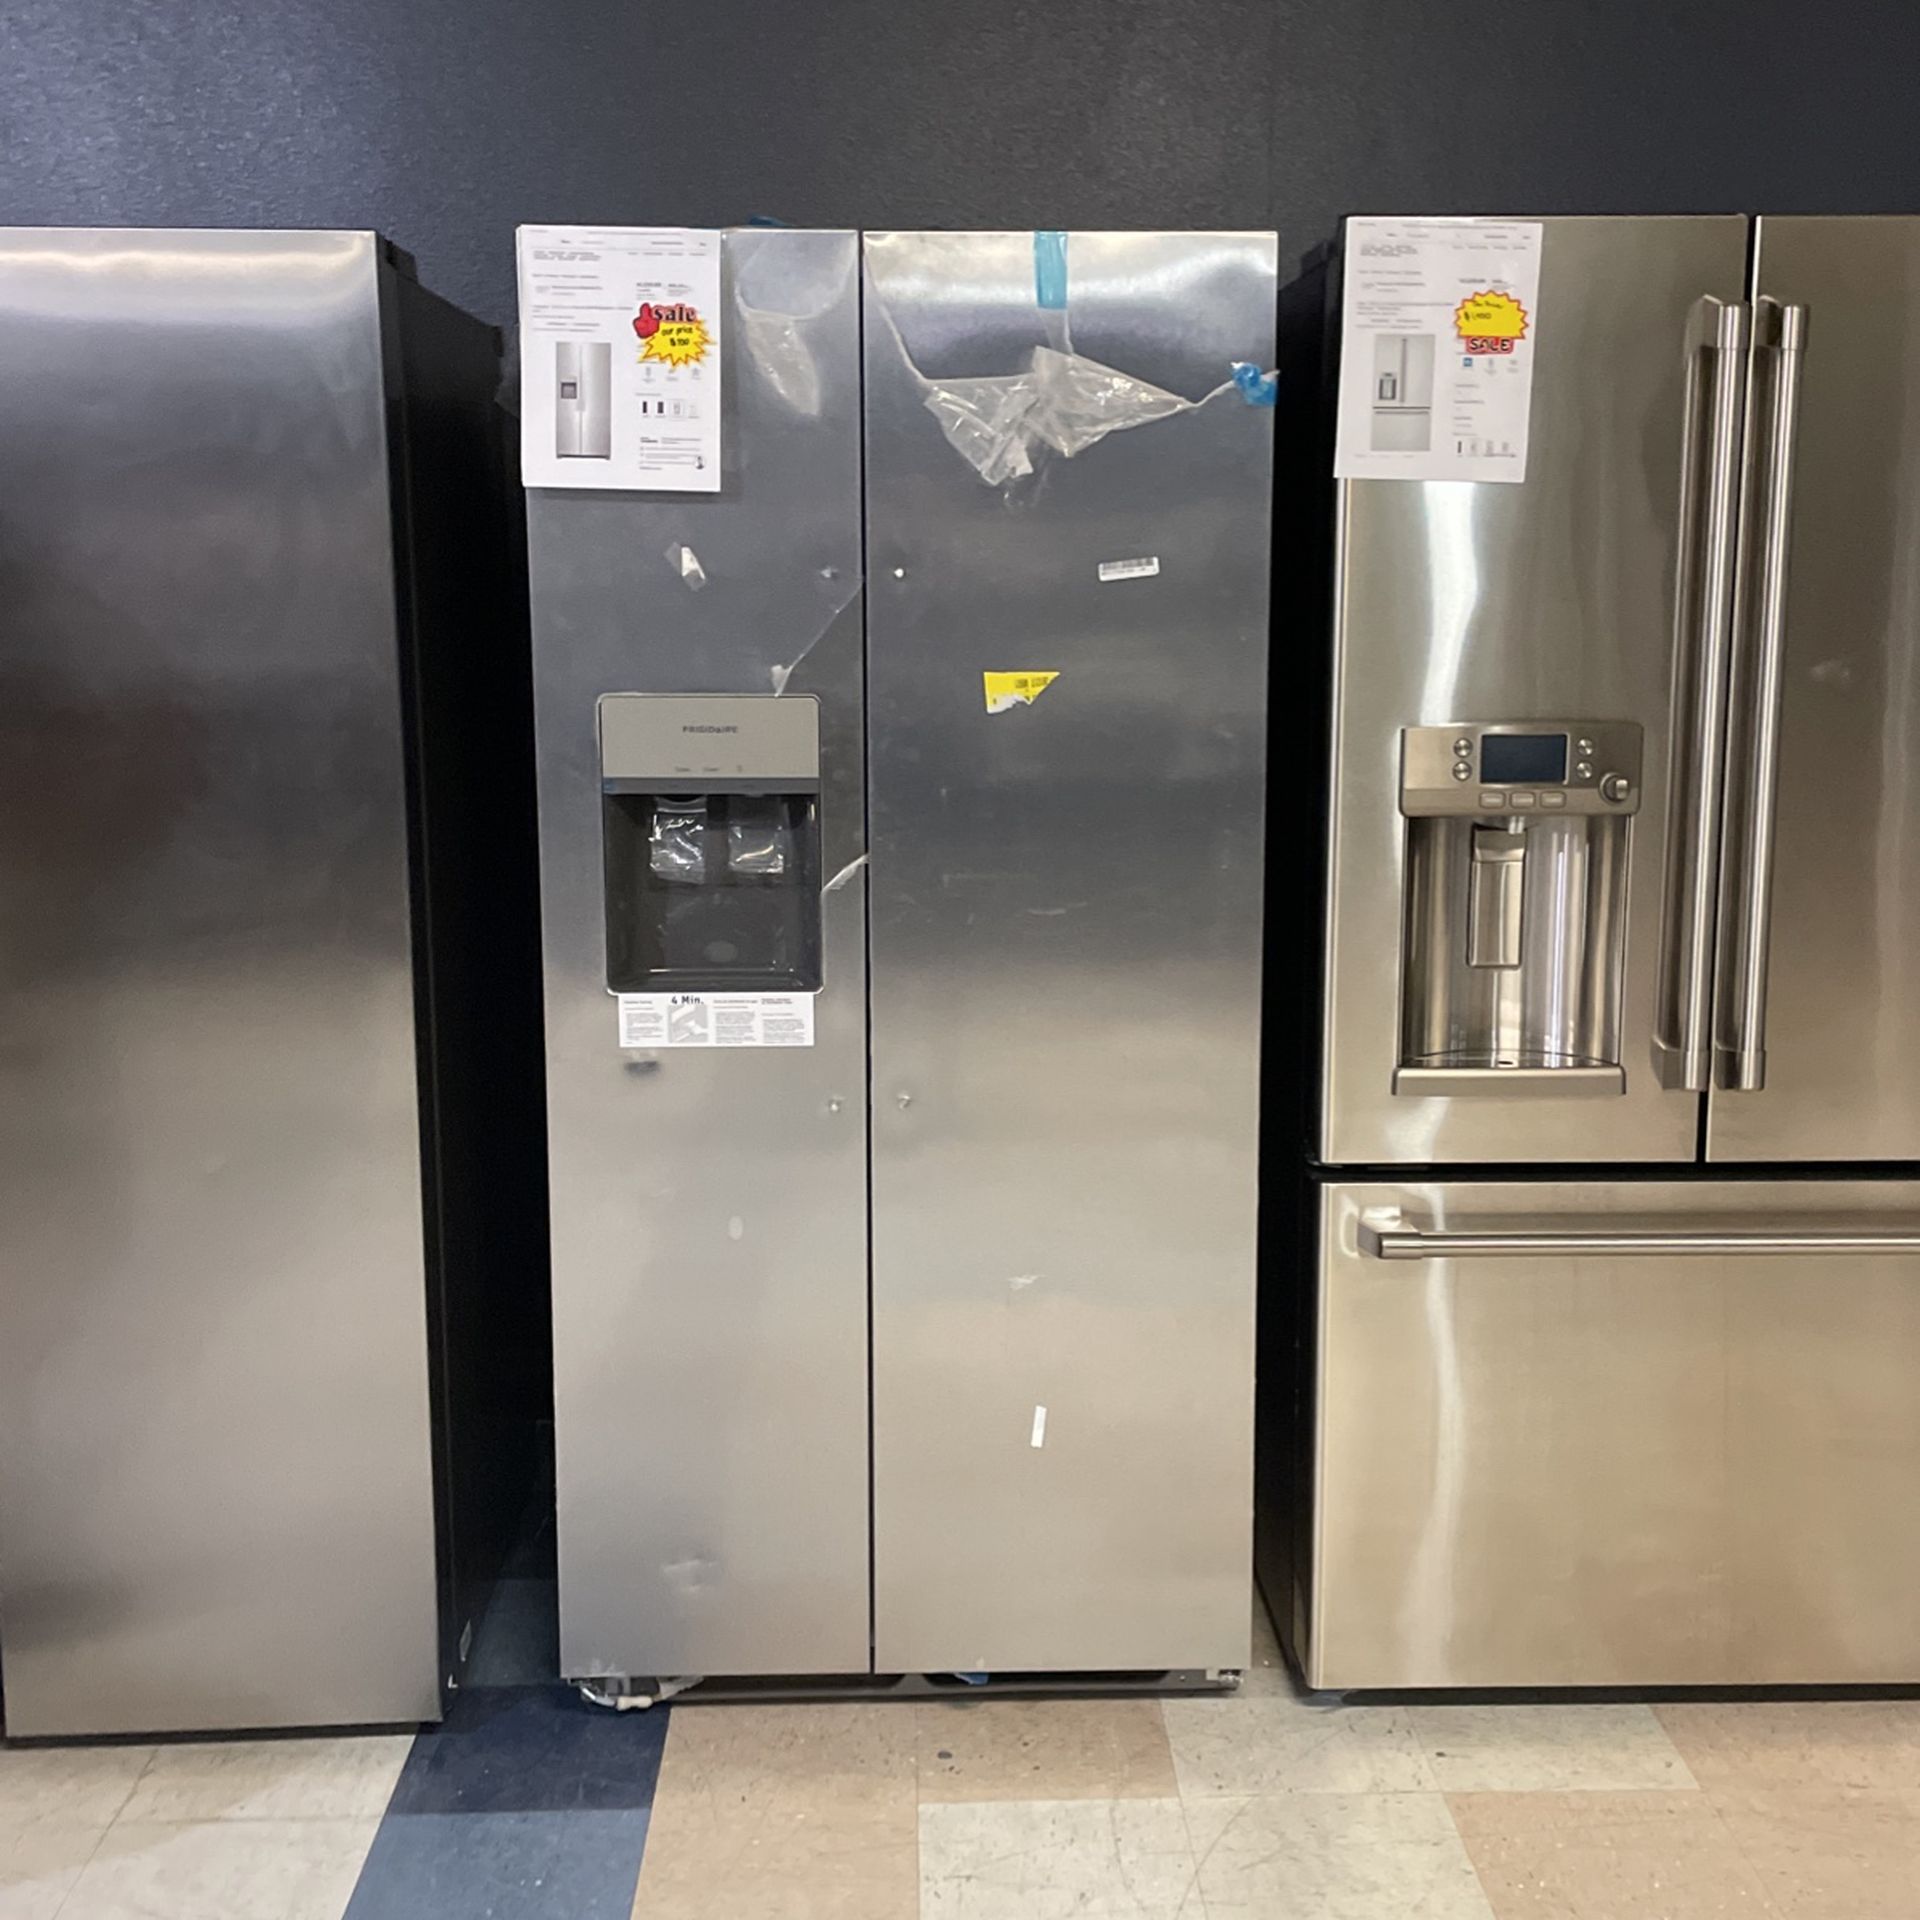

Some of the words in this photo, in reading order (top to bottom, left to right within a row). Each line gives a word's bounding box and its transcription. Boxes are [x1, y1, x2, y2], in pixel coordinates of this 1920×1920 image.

[1470, 338, 1511, 352] SALE
[671, 996, 678, 1004] 4
[681, 995, 704, 1005] Min.
